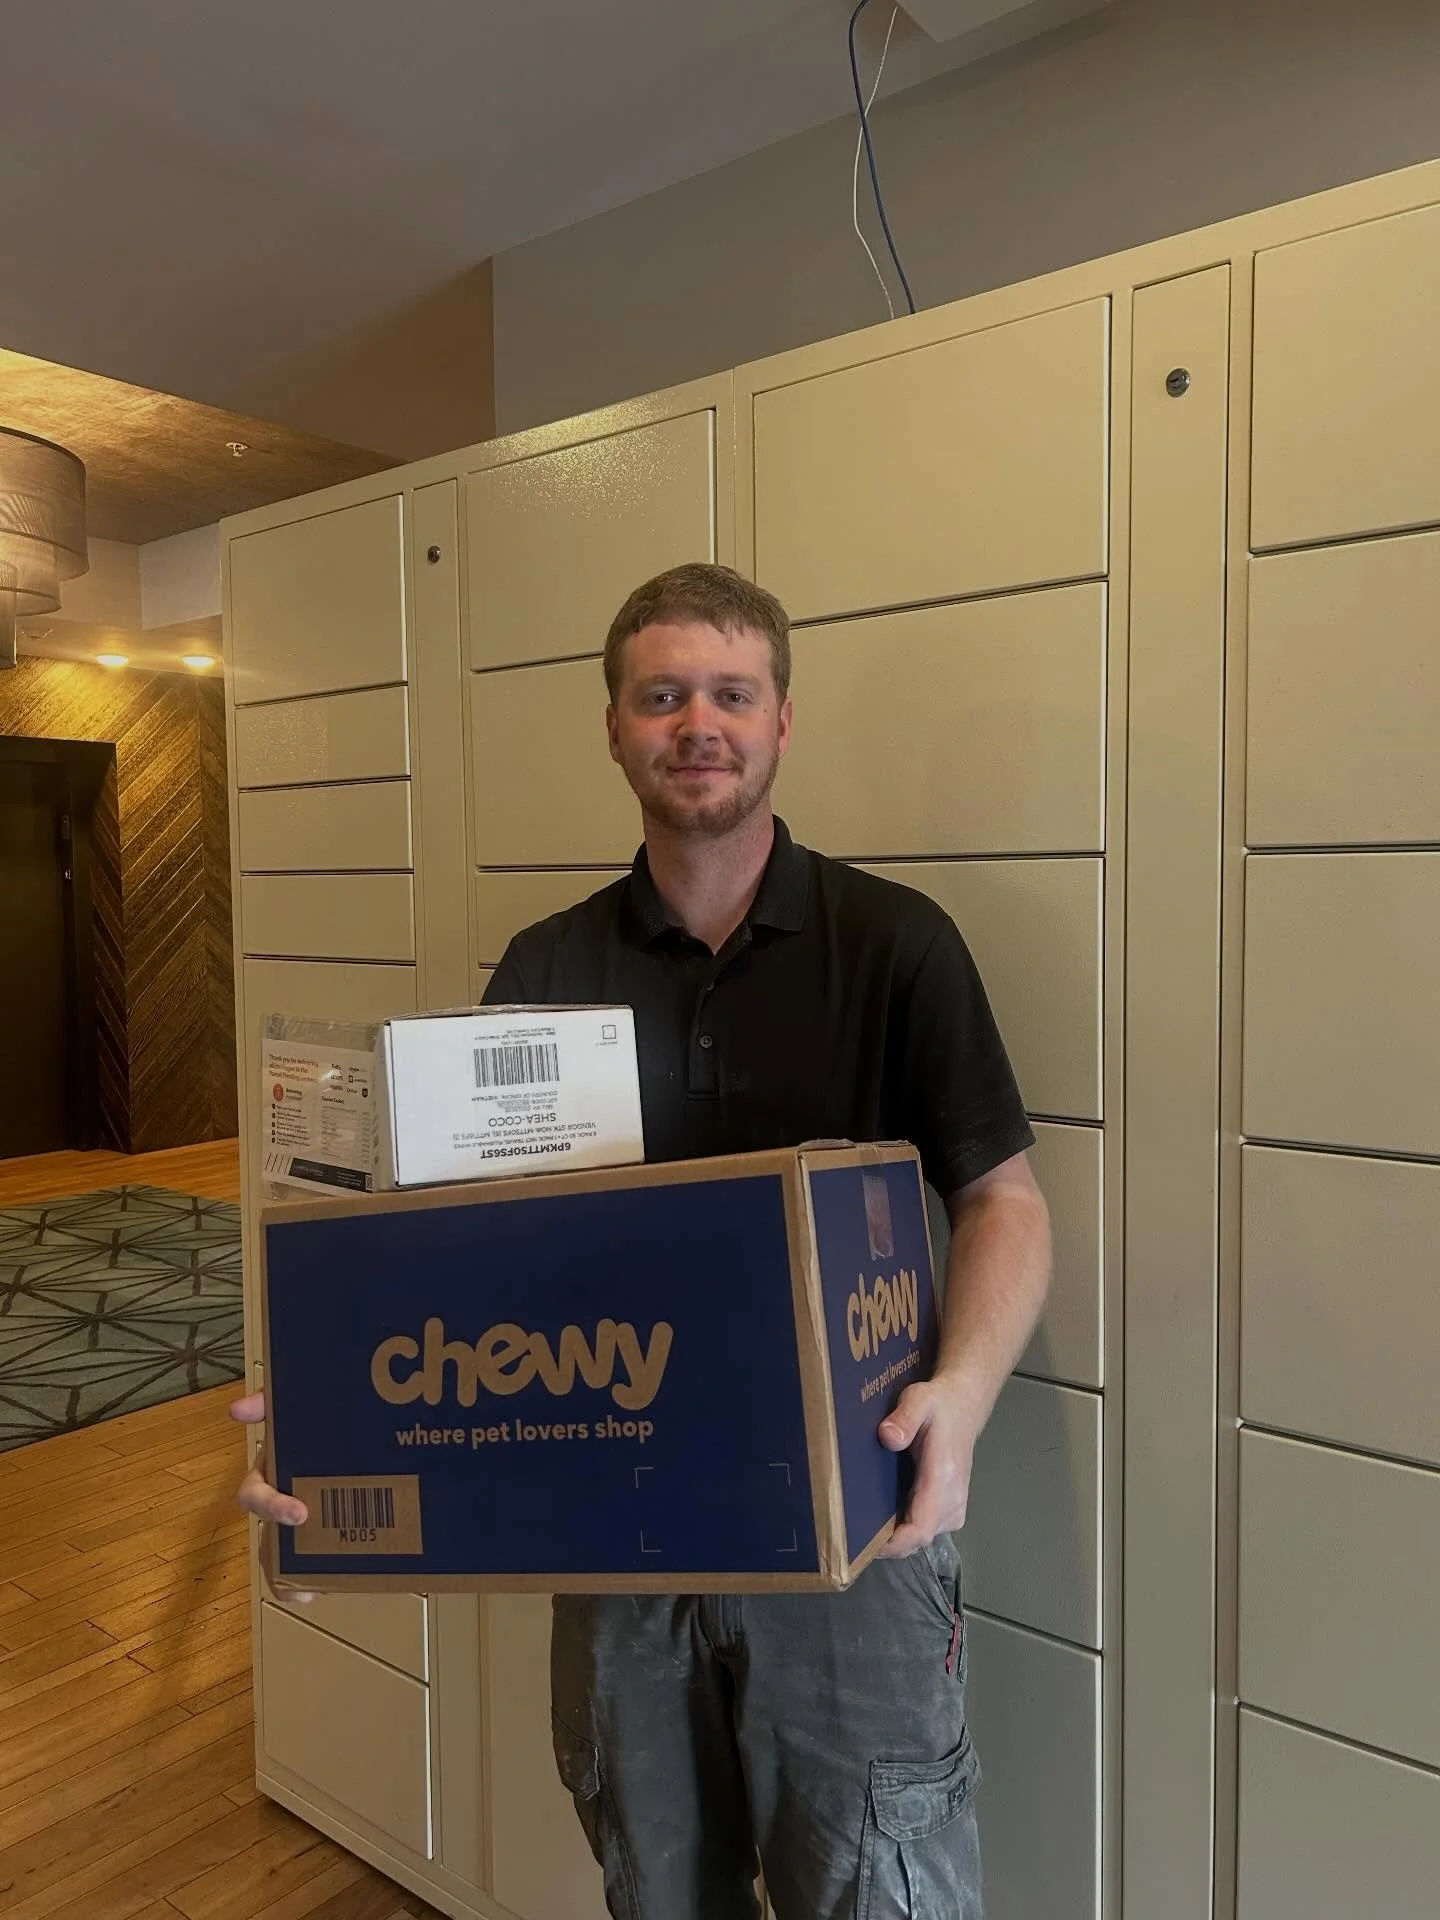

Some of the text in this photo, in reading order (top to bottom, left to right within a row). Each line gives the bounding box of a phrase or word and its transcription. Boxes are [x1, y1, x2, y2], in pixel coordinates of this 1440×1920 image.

[488, 1112, 557, 1127] SHEA-COCO
[567, 1122, 596, 1130] VENDOR
[480, 1142, 571, 1159] 6PKMTT50FS6ST
[847, 1268, 918, 1362] chewy
[370, 1317, 674, 1410] chewy
[861, 1349, 920, 1403] where pet lovers shop
[396, 1415, 654, 1449] where pet lovers shop
